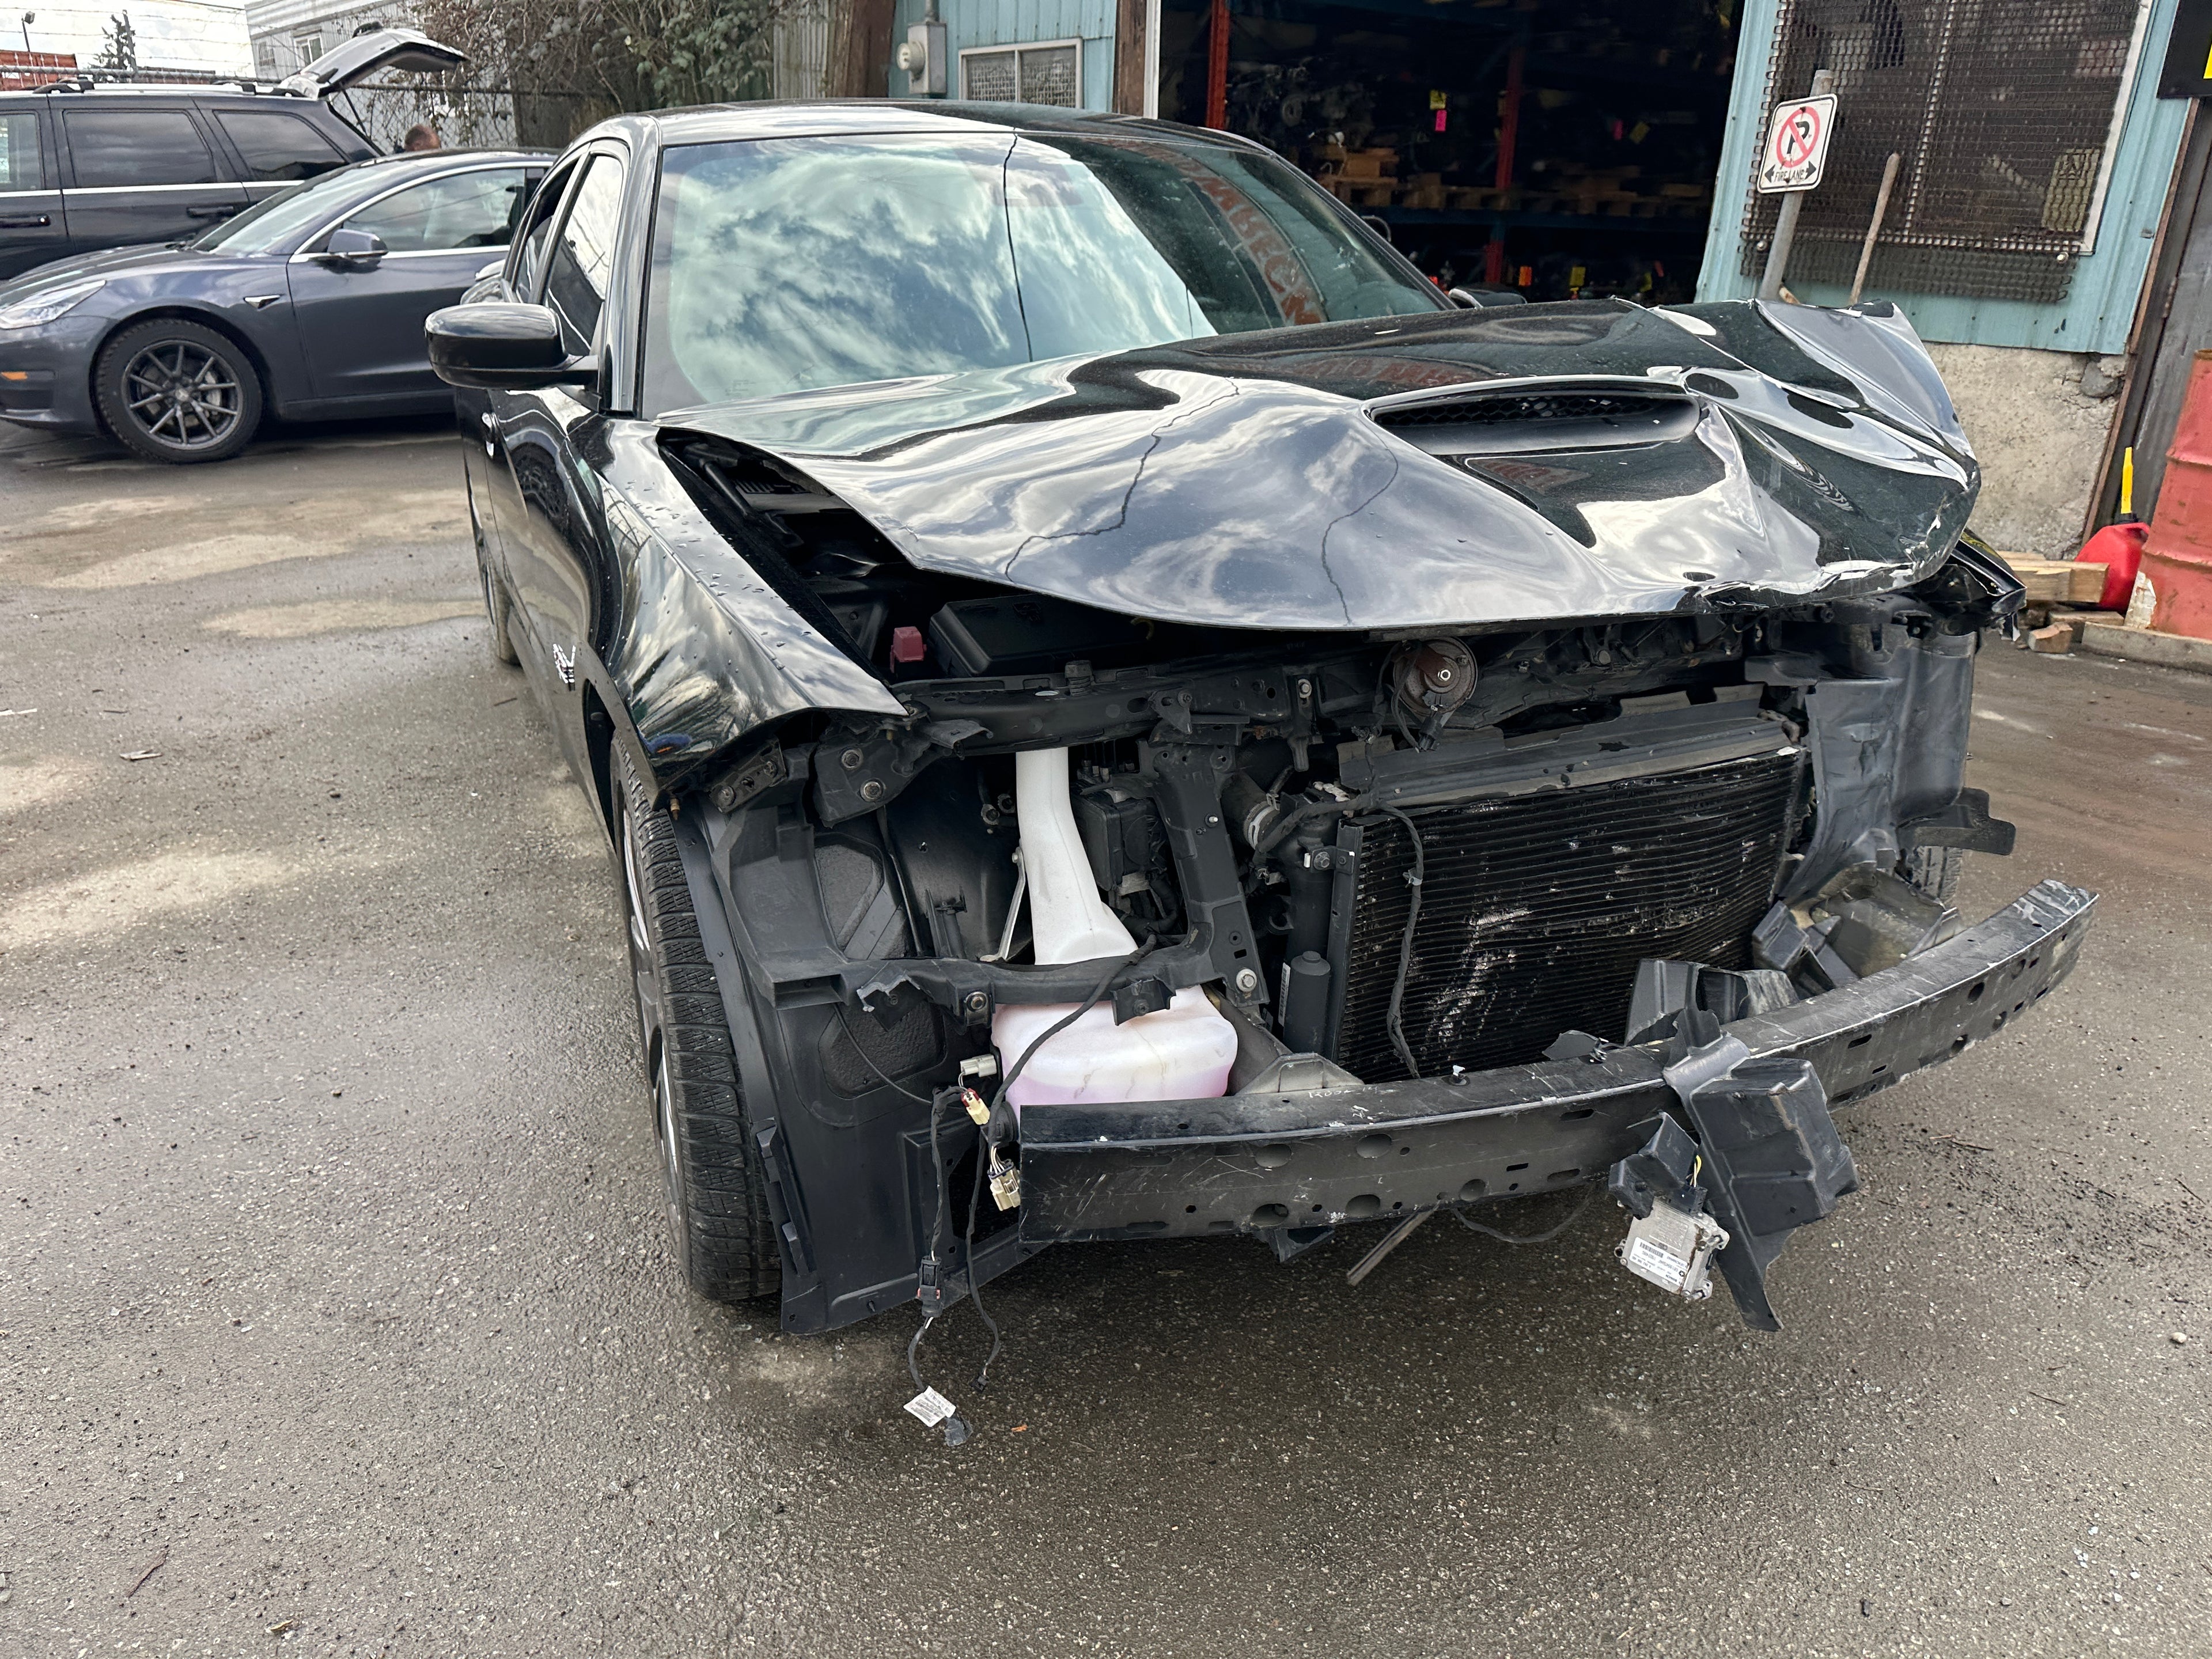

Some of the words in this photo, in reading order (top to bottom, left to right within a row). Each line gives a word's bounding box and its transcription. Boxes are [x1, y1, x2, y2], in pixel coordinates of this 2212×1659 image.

[1786, 120, 1810, 154] P
[1774, 171, 1788, 182] FIRE
[1789, 168, 1805, 180] LANE
